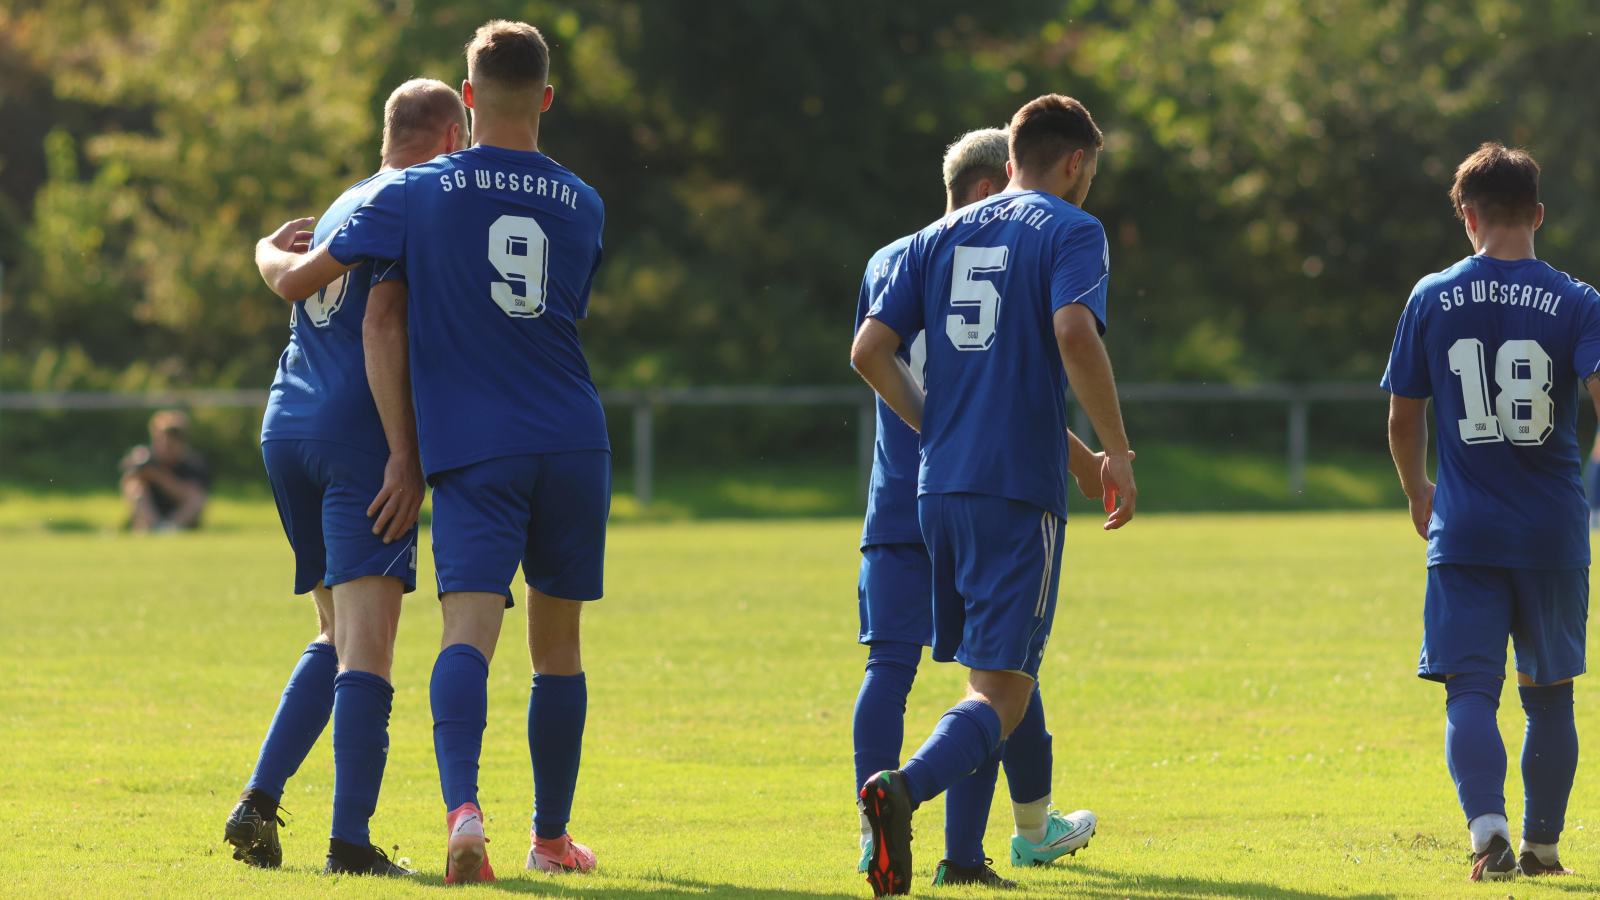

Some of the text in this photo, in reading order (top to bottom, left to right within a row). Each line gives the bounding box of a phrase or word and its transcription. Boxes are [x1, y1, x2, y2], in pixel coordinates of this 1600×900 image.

[440, 169, 579, 210] SG WESERTAL
[487, 214, 549, 318] 9
[945, 245, 1009, 352] 5
[1439, 280, 1562, 316] SG WESERTAL
[1447, 337, 1555, 446] 18
